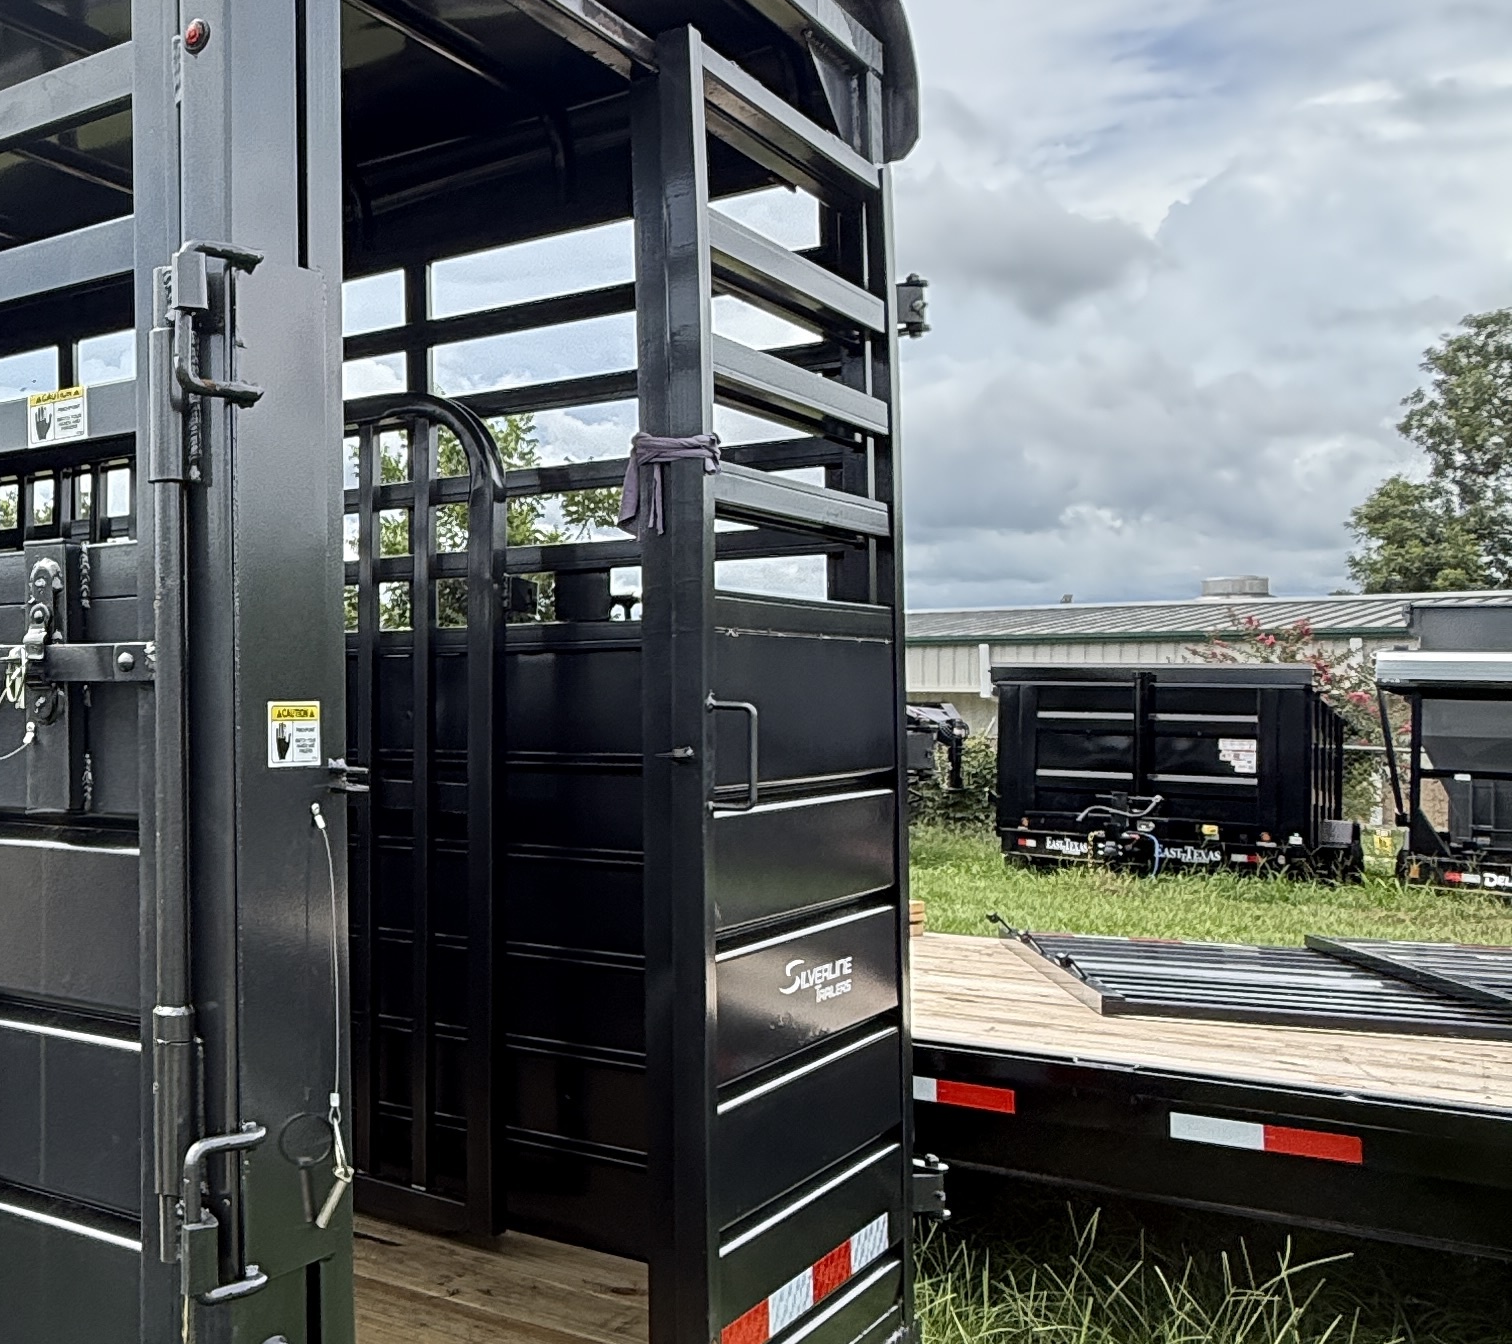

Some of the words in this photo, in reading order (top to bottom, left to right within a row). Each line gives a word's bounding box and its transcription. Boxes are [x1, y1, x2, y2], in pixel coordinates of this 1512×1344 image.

[1046, 836, 1064, 851] EAST
[1064, 837, 1088, 854] TEXAS
[1184, 845, 1221, 862] TEXAS
[779, 956, 853, 995] SILVERLINE
[814, 978, 853, 1003] TRAILERS
